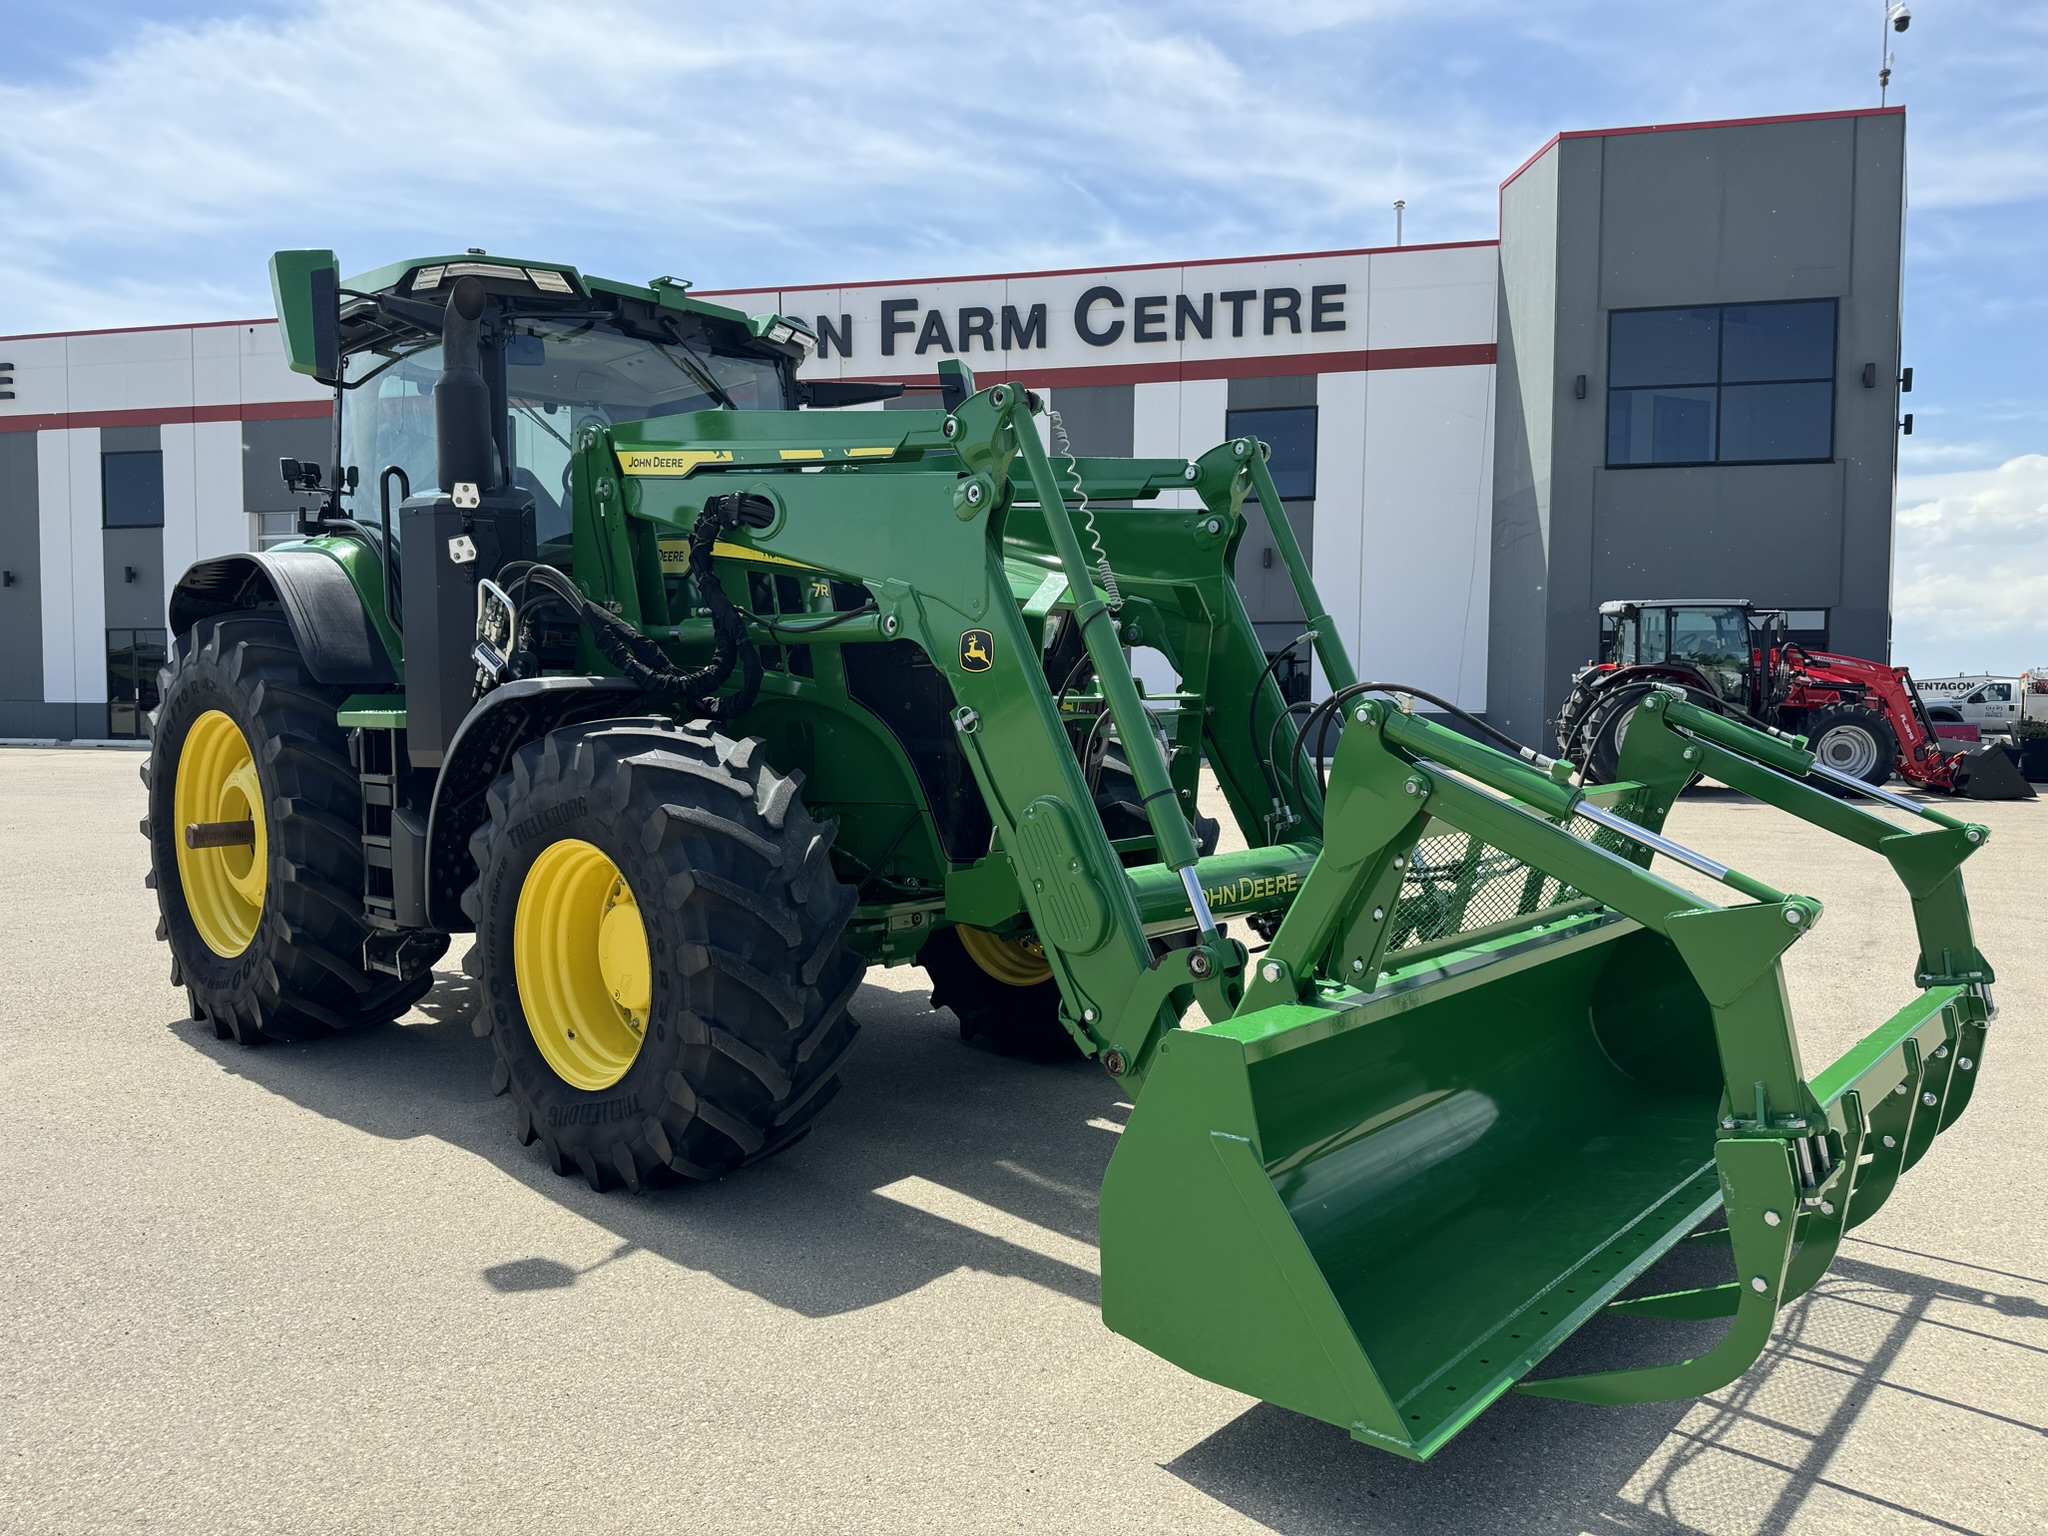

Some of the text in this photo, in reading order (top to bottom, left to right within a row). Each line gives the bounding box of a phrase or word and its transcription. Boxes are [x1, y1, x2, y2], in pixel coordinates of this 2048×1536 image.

[881, 298, 1047, 356] FARM
[1074, 283, 1347, 347] CENTRE
[628, 456, 684, 468] JOHN DEERE
[810, 581, 830, 598] 7R
[507, 795, 588, 849] TRELLEBORG
[1238, 873, 1298, 902] DEERE
[547, 1092, 645, 1128] TRELLEBORG
